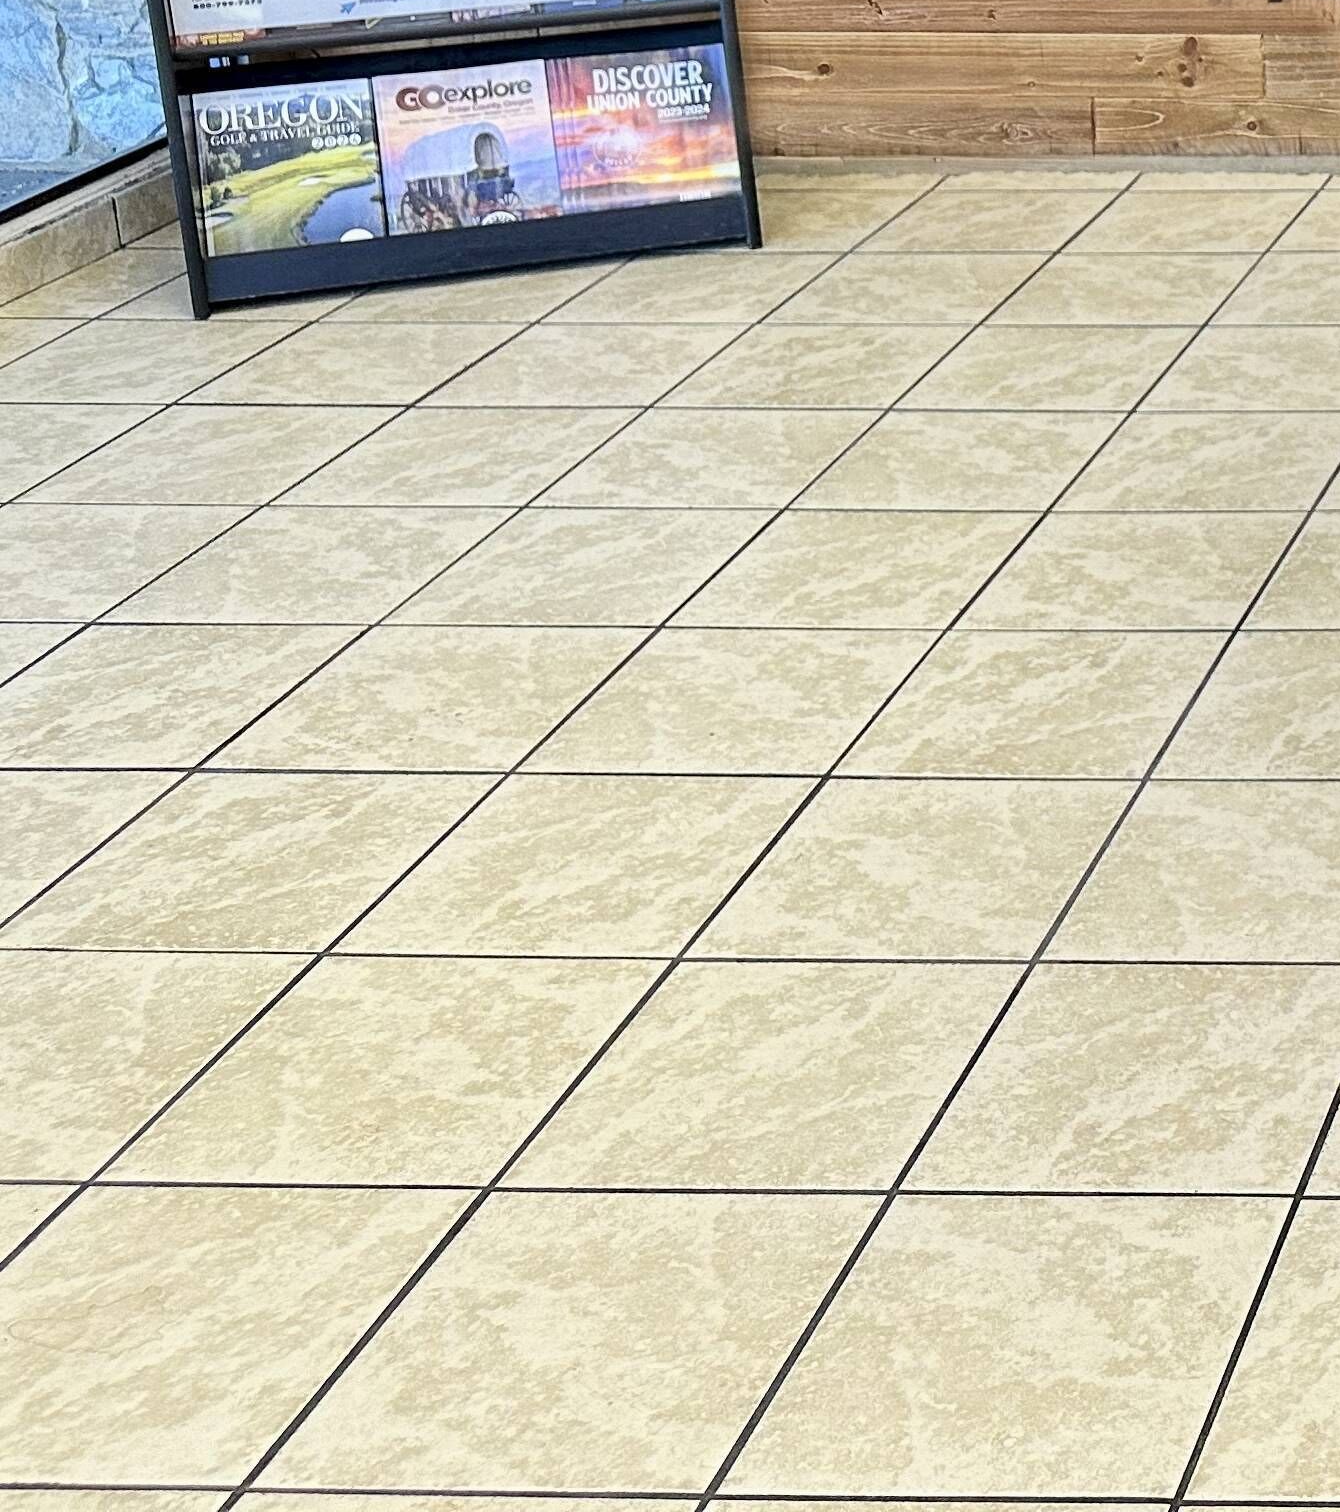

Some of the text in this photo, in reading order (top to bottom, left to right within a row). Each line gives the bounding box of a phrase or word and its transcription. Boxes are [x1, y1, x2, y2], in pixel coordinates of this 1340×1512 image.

[592, 60, 704, 93] DISCOVER
[586, 83, 713, 112] UNION COUNTY
[657, 103, 711, 120] 2023-2024
[199, 93, 364, 136] OREGON
[210, 123, 360, 147] GOLF & TRAVEL GUIDE
